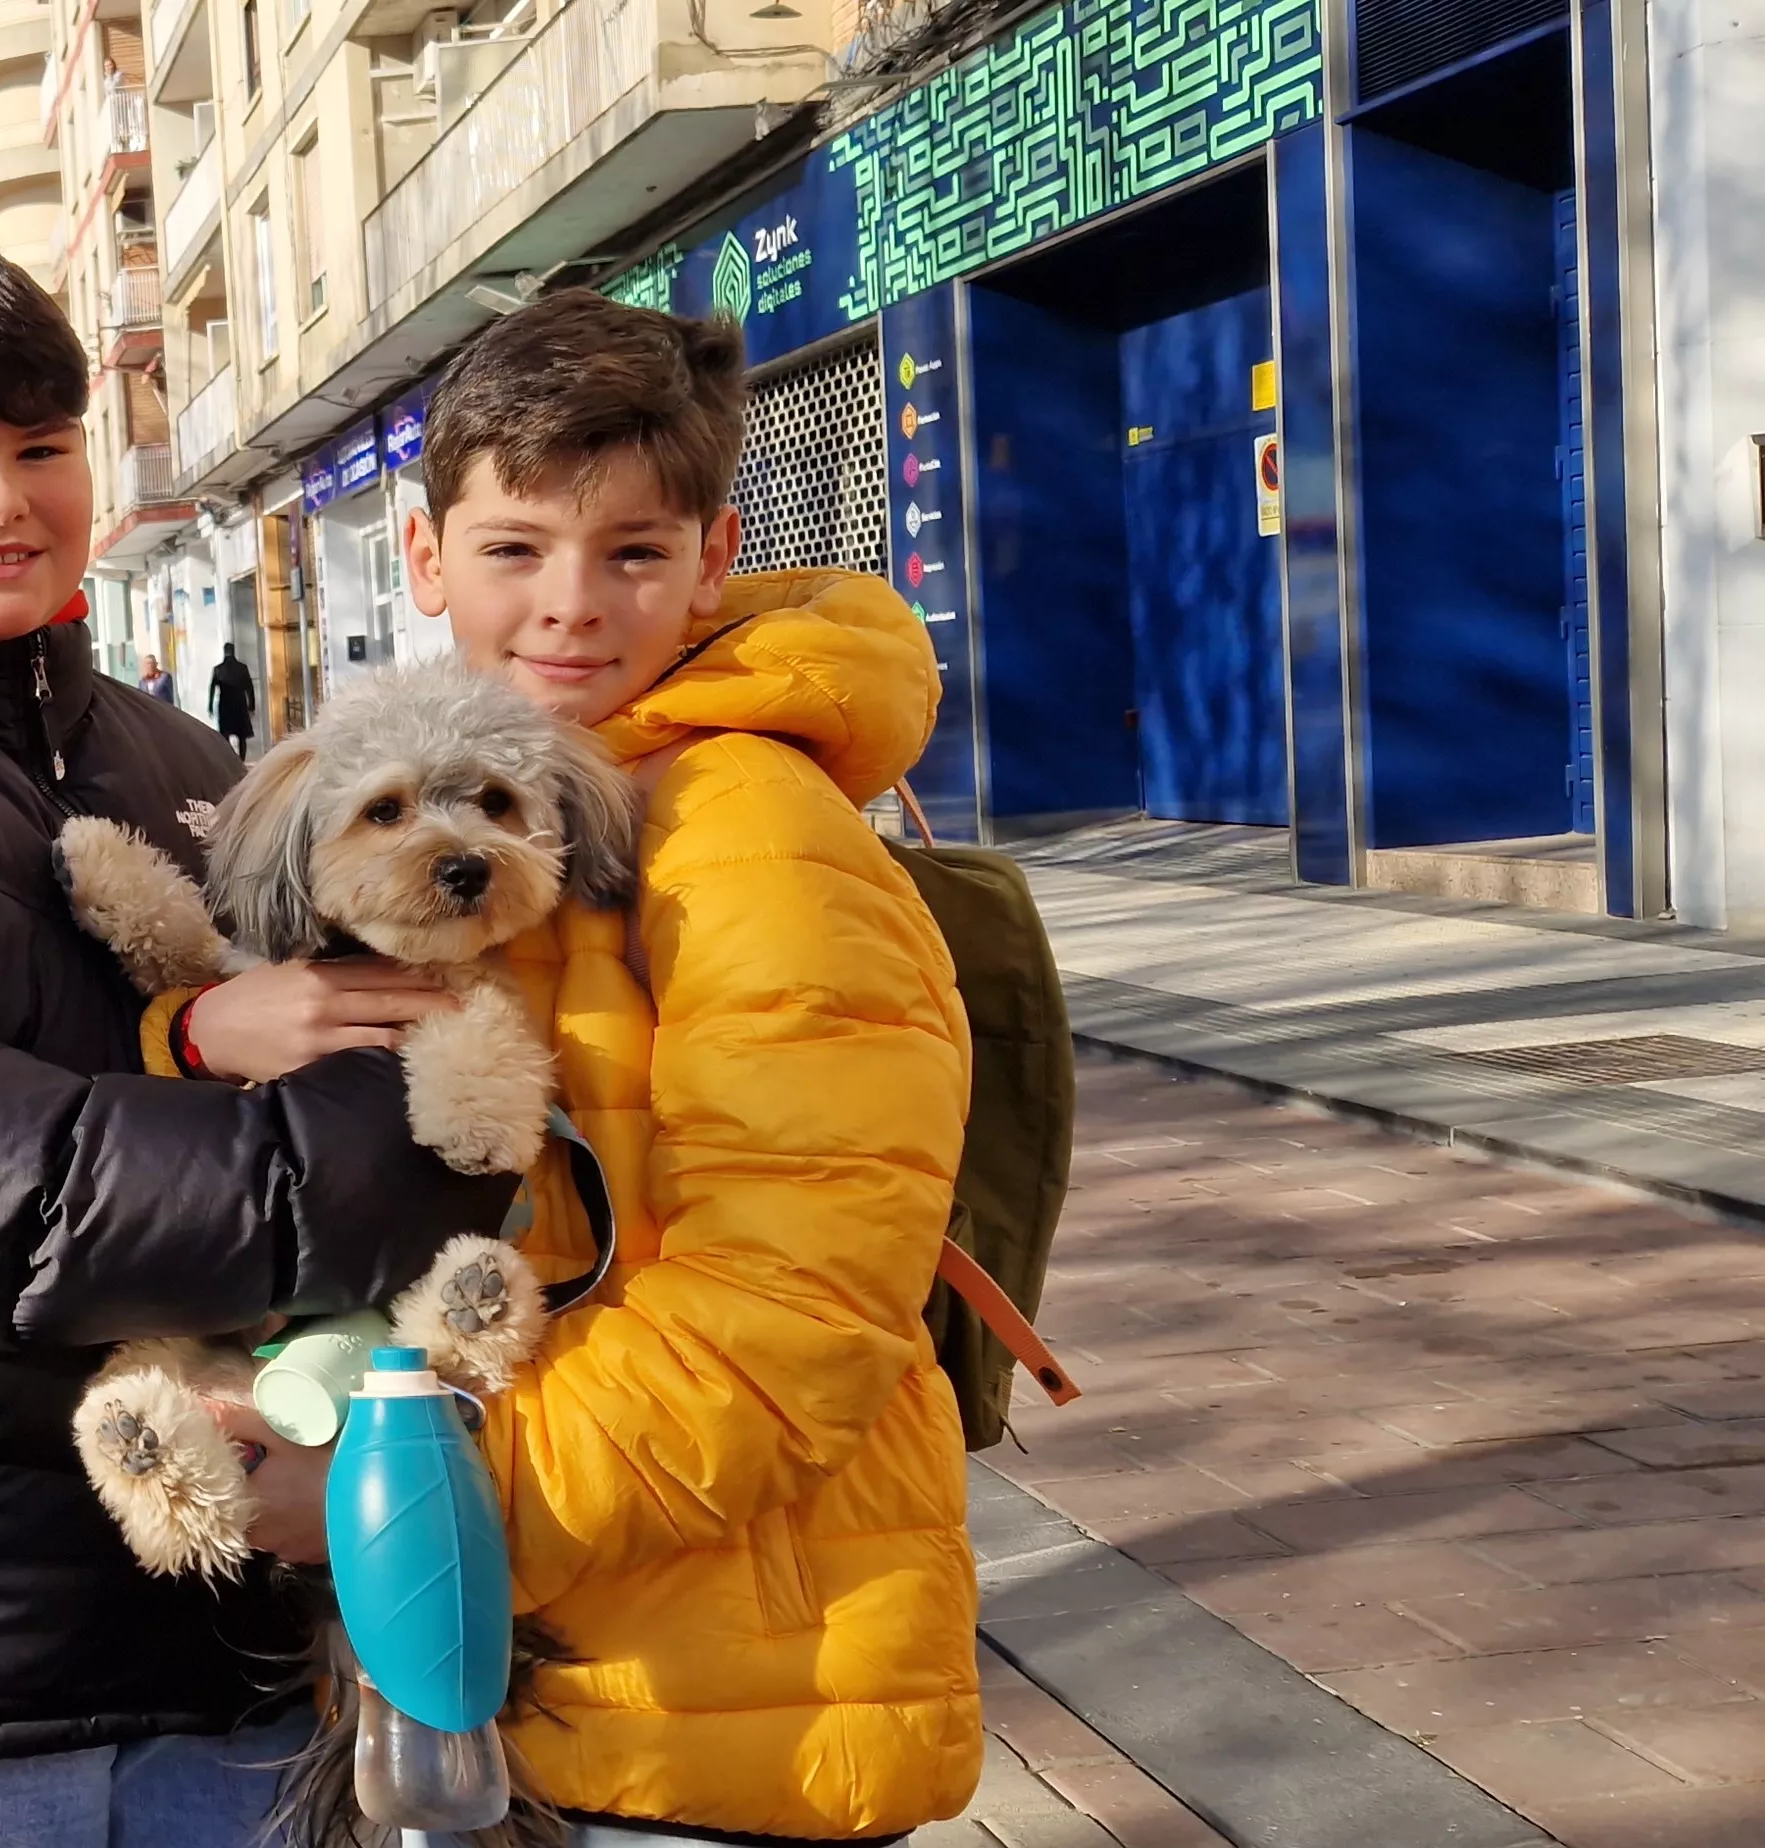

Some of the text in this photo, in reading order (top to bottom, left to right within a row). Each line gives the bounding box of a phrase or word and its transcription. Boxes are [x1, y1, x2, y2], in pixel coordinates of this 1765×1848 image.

[755, 214, 799, 262] Zynk
[757, 248, 813, 290] soluciones
[758, 280, 802, 313] digitales
[185, 798, 209, 814] THE
[189, 825, 210, 838] FAC
